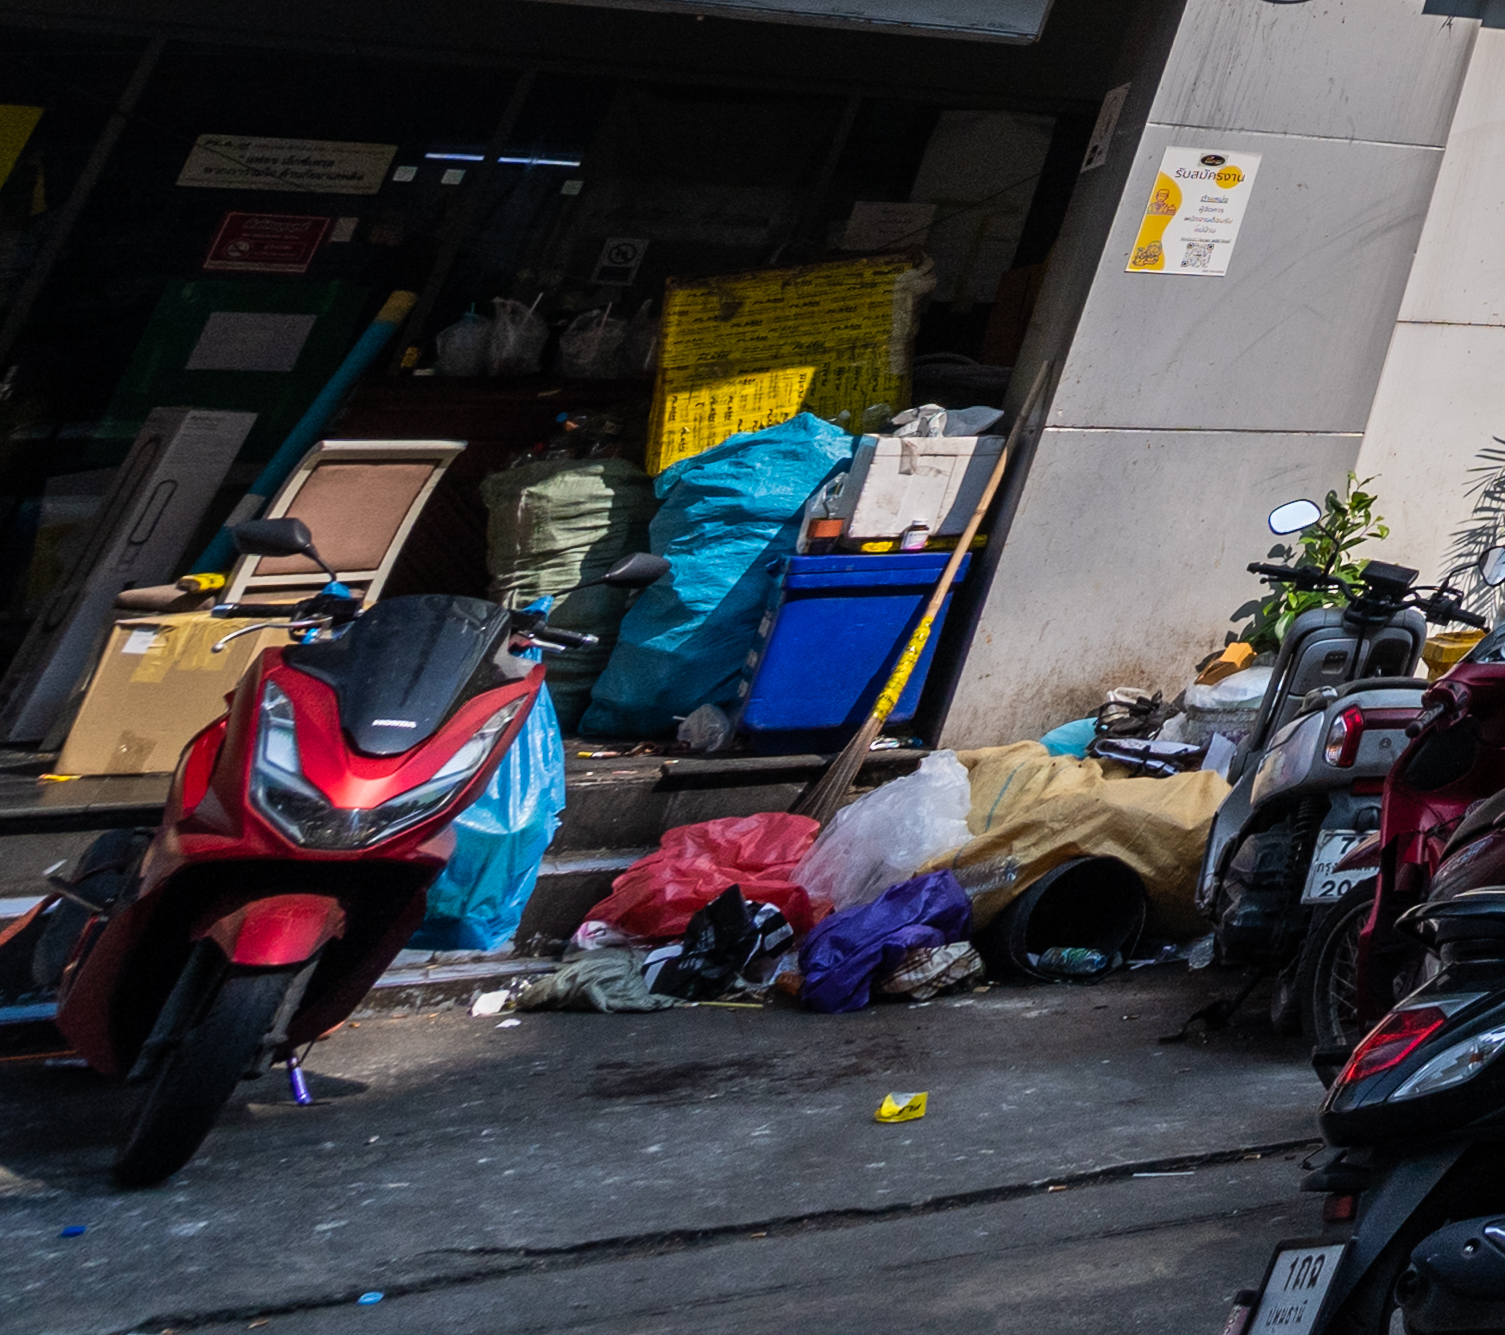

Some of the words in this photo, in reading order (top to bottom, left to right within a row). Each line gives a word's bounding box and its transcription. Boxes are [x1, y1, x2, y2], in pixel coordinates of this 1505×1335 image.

[1174, 168, 1246, 183] รับสมัครงาน
[371, 718, 417, 729] HONDA
